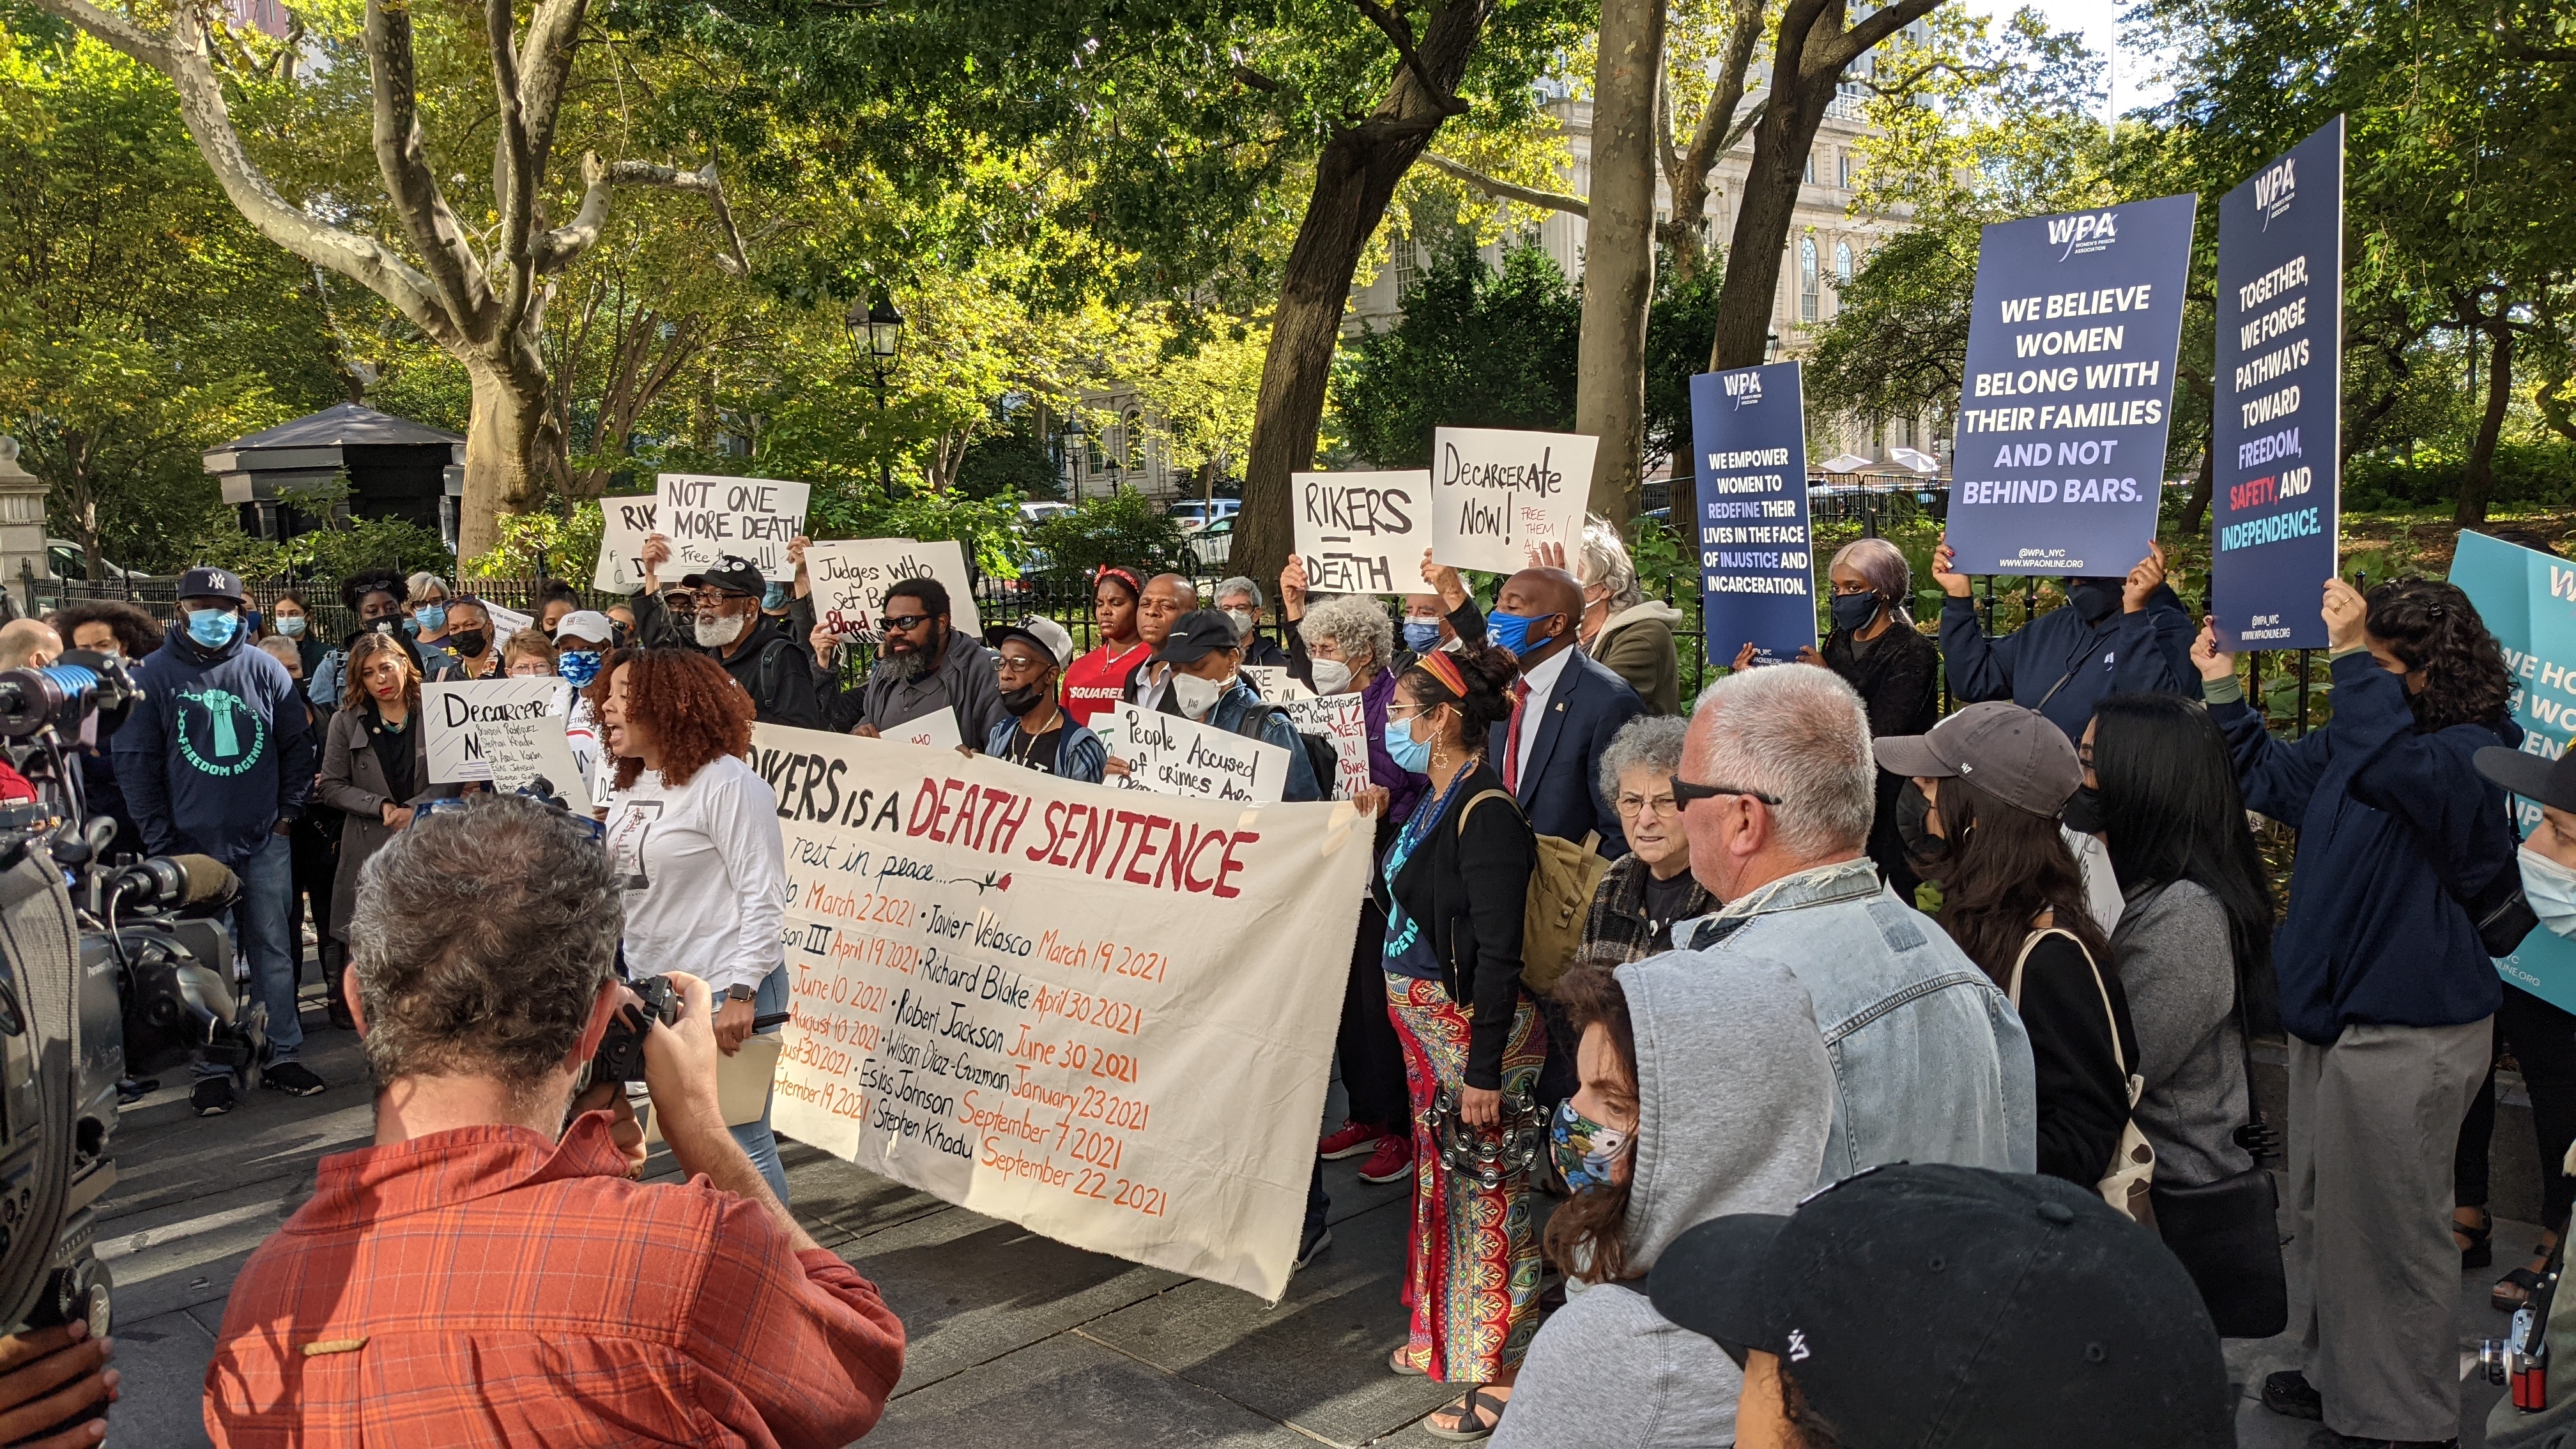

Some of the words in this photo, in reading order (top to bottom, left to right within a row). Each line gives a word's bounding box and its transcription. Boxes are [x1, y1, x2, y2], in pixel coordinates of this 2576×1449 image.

[2255, 158, 2296, 211] WPA
[2048, 212, 2116, 245] WPA
[2240, 256, 2308, 312] TOGETHER,
[2001, 296, 2042, 323] WE
[2046, 284, 2151, 319] BELIEVE
[2016, 325, 2124, 358] WOMEN
[2241, 319, 2260, 351] WE
[2262, 297, 2306, 342] FORGE
[1975, 367, 2078, 397] BELONG
[2085, 360, 2159, 390] WITH
[2235, 338, 2309, 393] PATHWAYS
[1724, 372, 1762, 396] WPA
[1965, 407, 2035, 433] THEIR
[2039, 399, 2163, 430] FAMILIES
[2242, 386, 2300, 429] TOWARD
[1708, 452, 1728, 470] WE
[1728, 448, 1788, 469] EMPOWER
[1993, 442, 2053, 468] AND
[2057, 440, 2118, 466] NOT
[2239, 427, 2302, 470] FREEDOM,
[668, 479, 717, 509] NOT
[727, 485, 779, 514] ONE
[1717, 475, 1764, 494] WOMEN
[1765, 474, 1782, 492] TO
[1962, 479, 2058, 505] BEHIND
[2062, 477, 2143, 503] BARS.
[2230, 475, 2278, 511] SAFETY,
[2280, 466, 2312, 500] AND
[620, 503, 657, 532] RIK
[674, 510, 733, 542] MORE
[742, 514, 803, 543] DEATH
[1305, 482, 1413, 537] RIKERS
[1521, 507, 1547, 521] FREE
[1708, 502, 1760, 519] REDEFINE
[1761, 500, 1796, 518] THEIR
[1524, 523, 1556, 537] THEM
[1703, 527, 1733, 544] LIVES
[1735, 527, 1748, 543] IN
[1748, 526, 1771, 543] THE
[1772, 526, 1805, 544] FACE
[2221, 507, 2321, 551] INDEPENDENCE.
[680, 544, 711, 564] Free
[1703, 551, 1719, 568] OF
[1720, 551, 1779, 569] INJUSTICE
[1781, 552, 1808, 569] AND
[2000, 559, 2083, 569] WWW.WPAONLINE.ORG
[2018, 548, 2066, 558] @WPA_NYC
[818, 556, 880, 589] Judges
[885, 554, 933, 580] WHO
[1307, 555, 1393, 592] DEATH
[1708, 575, 1807, 595] INCARCERATION.
[825, 610, 871, 635] Blood
[1309, 709, 1334, 725] Khadu
[1337, 720, 1365, 739] REST
[178, 737, 231, 776] FREEDOM
[233, 732, 264, 775] AGENDA
[1125, 709, 1177, 762] People
[1186, 733, 1260, 787] Accused
[1129, 751, 1148, 772] of
[1344, 740, 1357, 756] IN
[790, 834, 838, 870] rest
[838, 843, 870, 877] in
[841, 788, 875, 829] IS
[871, 790, 900, 832] A
[906, 777, 1033, 854] DEATH
[1025, 799, 1261, 899] SENTENCE
[805, 879, 855, 918] March
[856, 893, 873, 921] 2
[872, 894, 916, 928] 2021
[926, 903, 974, 941] Javier
[974, 911, 1032, 957] Velasco
[1036, 928, 1087, 969] March
[1091, 940, 1115, 974] 19
[1116, 946, 1168, 984] 2021
[1388, 916, 1420, 958] AGEND
[802, 923, 833, 956] III
[830, 930, 864, 970] April
[866, 937, 887, 967] 19
[885, 941, 920, 976] 2021
[921, 946, 982, 993] Richard
[1031, 984, 1071, 1024] April
[1064, 992, 1091, 1022] 30
[1089, 998, 1142, 1036] 2021
[792, 963, 829, 1000] June
[831, 974, 848, 1004] 10
[850, 981, 888, 1015] 2021
[895, 988, 941, 1035] Robert
[940, 1000, 1004, 1054] Jackson
[1006, 1023, 1057, 1066] June
[1058, 1039, 1087, 1070] 30
[1090, 1047, 1138, 1084] 2021
[787, 1000, 832, 1041] August
[833, 1014, 848, 1043] 10
[848, 1020, 880, 1052] 2021
[886, 1027, 921, 1067] Wilson
[920, 1038, 1009, 1094] Diaz-Guzman
[1011, 1063, 1080, 1124] January
[1078, 1085, 1107, 1119] 23
[1105, 1095, 1150, 1132] 2021
[779, 1037, 804, 1066] gust
[800, 1040, 822, 1068] 30
[818, 1045, 852, 1078] 2021
[858, 1058, 894, 1096] Esias
[894, 1068, 954, 1119] Johnson
[958, 1089, 1052, 1146] September
[1055, 1121, 1071, 1152] 7
[1070, 1127, 1123, 1171] 2021
[820, 1080, 835, 1111] 19
[832, 1087, 871, 1124] 2021
[873, 1096, 921, 1140] Stephen
[921, 1116, 974, 1161] Khadu
[981, 1135, 1075, 1188] September
[1073, 1167, 1108, 1200] 22
[1113, 1178, 1167, 1218] 2021
